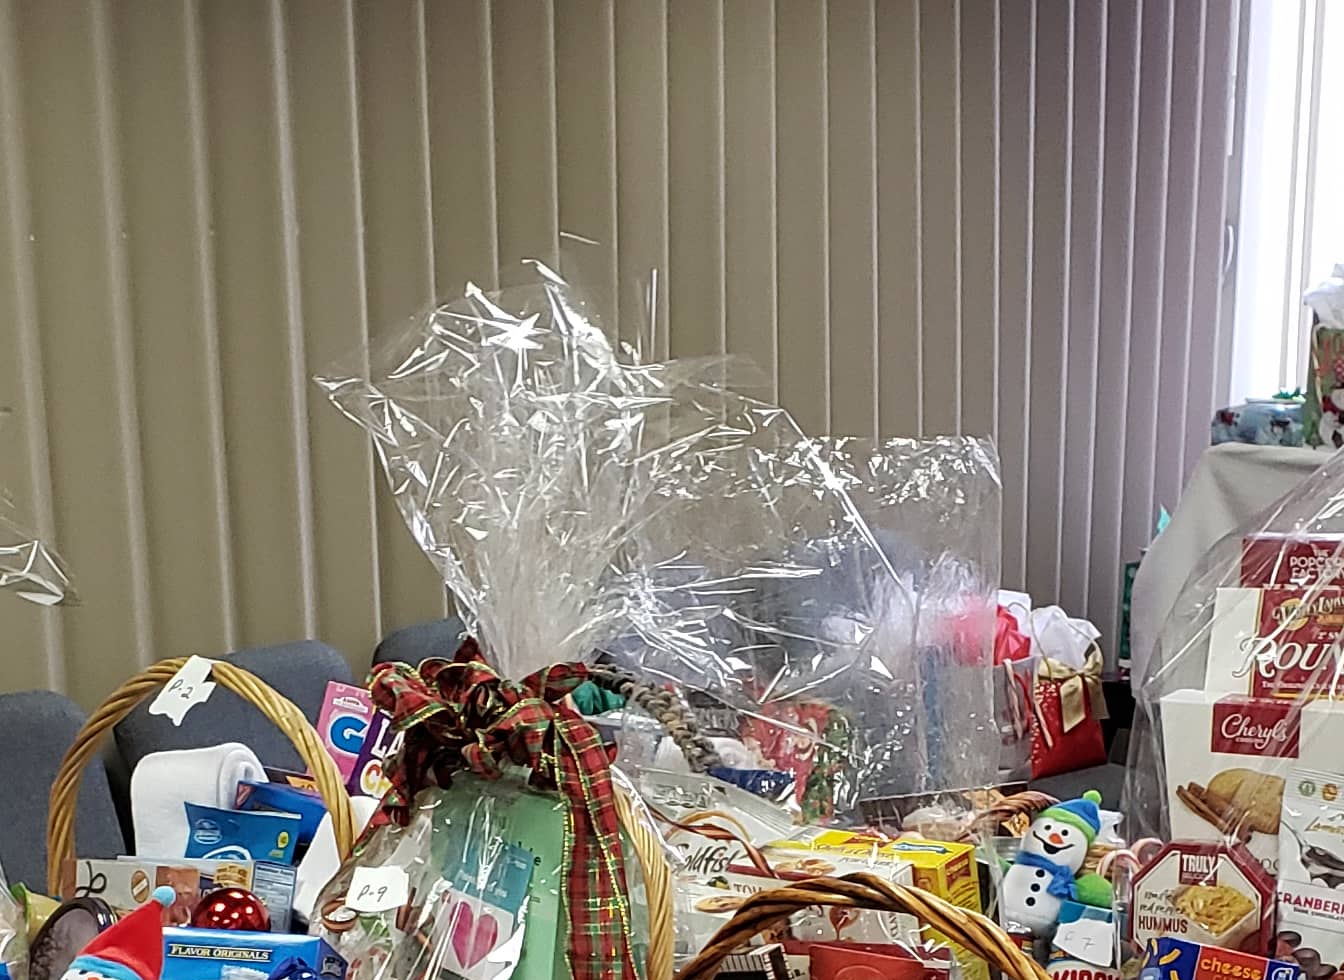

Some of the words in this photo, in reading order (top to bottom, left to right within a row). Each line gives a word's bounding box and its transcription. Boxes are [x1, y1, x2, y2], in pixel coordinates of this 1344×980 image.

[1182, 855, 1218, 874] TRULY
[1138, 914, 1188, 934] HUMMUS
[169, 944, 211, 958] FLAVOR
[212, 948, 270, 961] ORIGINALS
